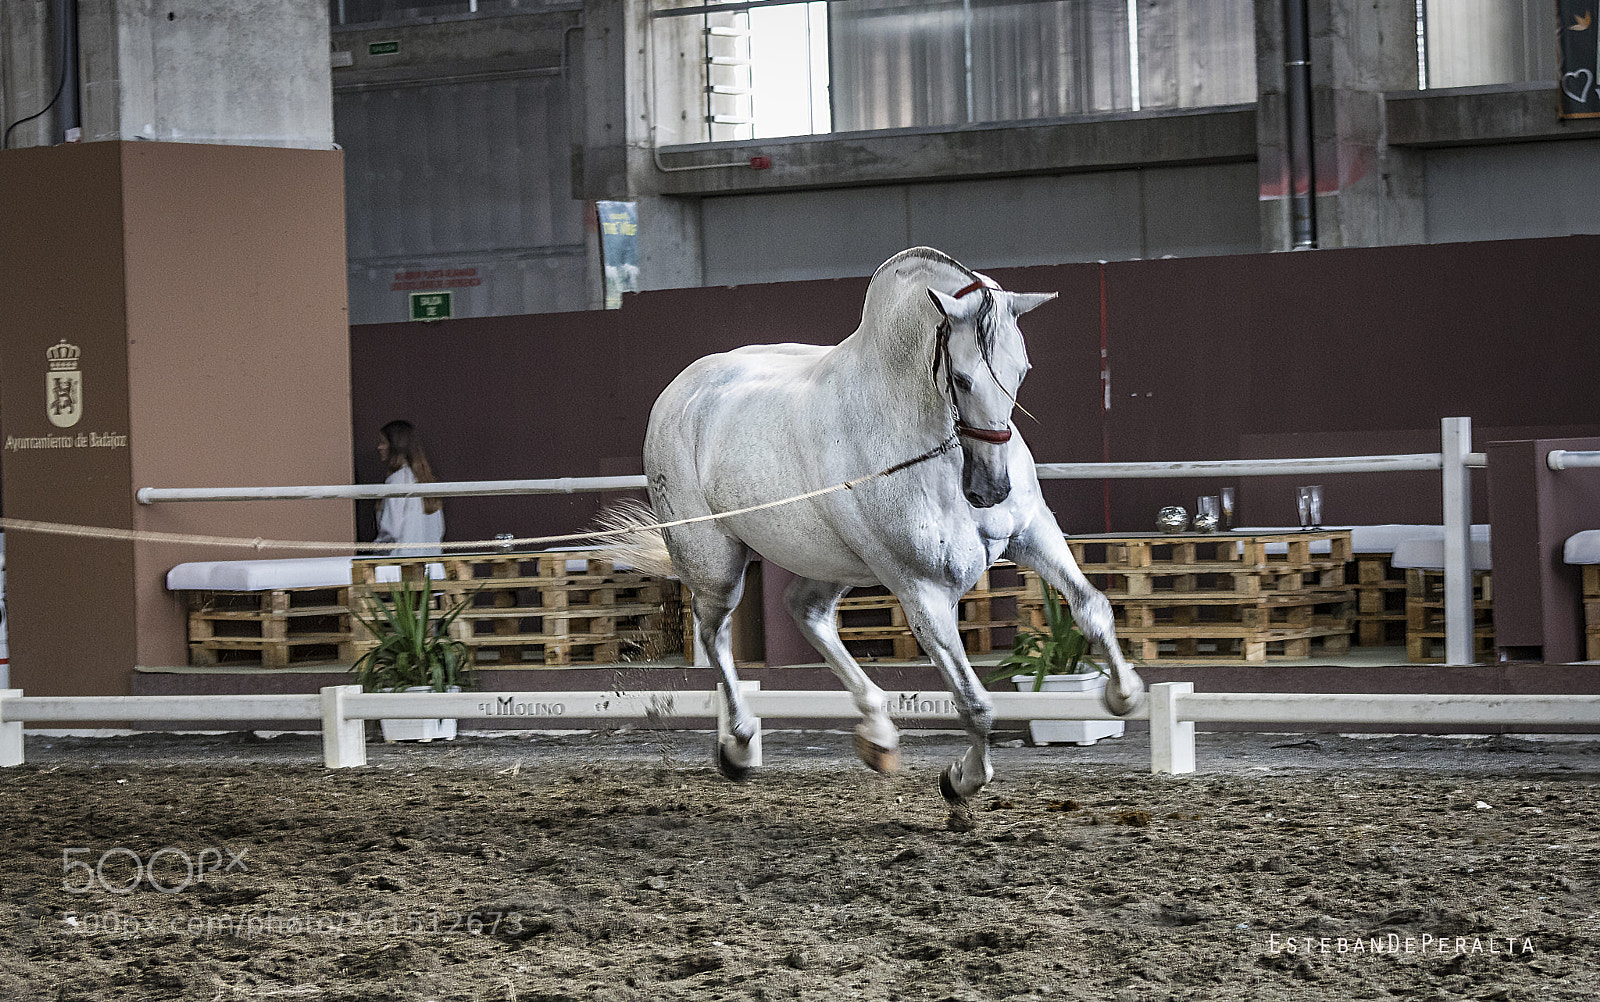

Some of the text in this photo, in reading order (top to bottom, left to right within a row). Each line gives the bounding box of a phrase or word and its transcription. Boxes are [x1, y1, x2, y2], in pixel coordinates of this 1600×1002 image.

[4, 432, 128, 453] Ayuntamiento de Badajoz
[496, 696, 566, 716] MOLINO
[898, 693, 959, 714] MOLIN
